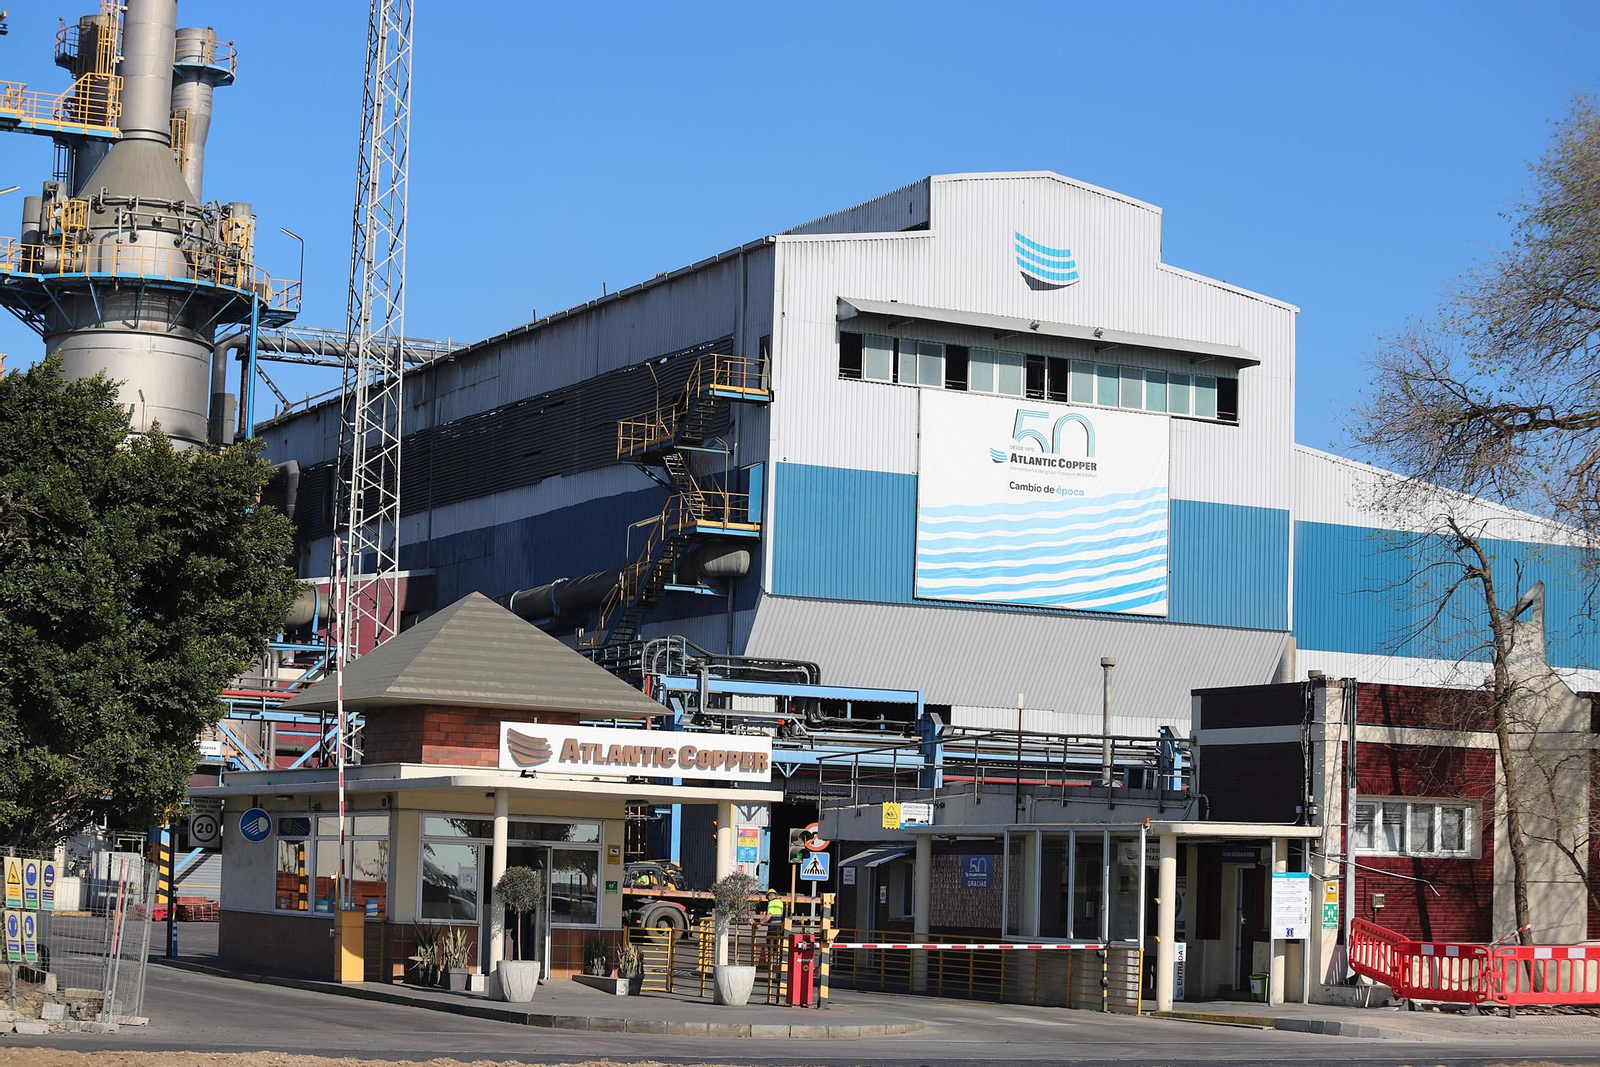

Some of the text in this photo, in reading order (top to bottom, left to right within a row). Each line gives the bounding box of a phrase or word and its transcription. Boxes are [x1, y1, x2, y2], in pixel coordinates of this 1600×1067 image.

[1012, 408, 1096, 458] 50
[1010, 444, 1024, 452] DESDE
[1010, 452, 1097, 471] ATLANTIC COPPER
[1009, 481, 1085, 497] Cambio de época
[559, 737, 769, 773] ATLANTIC COPPER
[196, 823, 214, 834] 20
